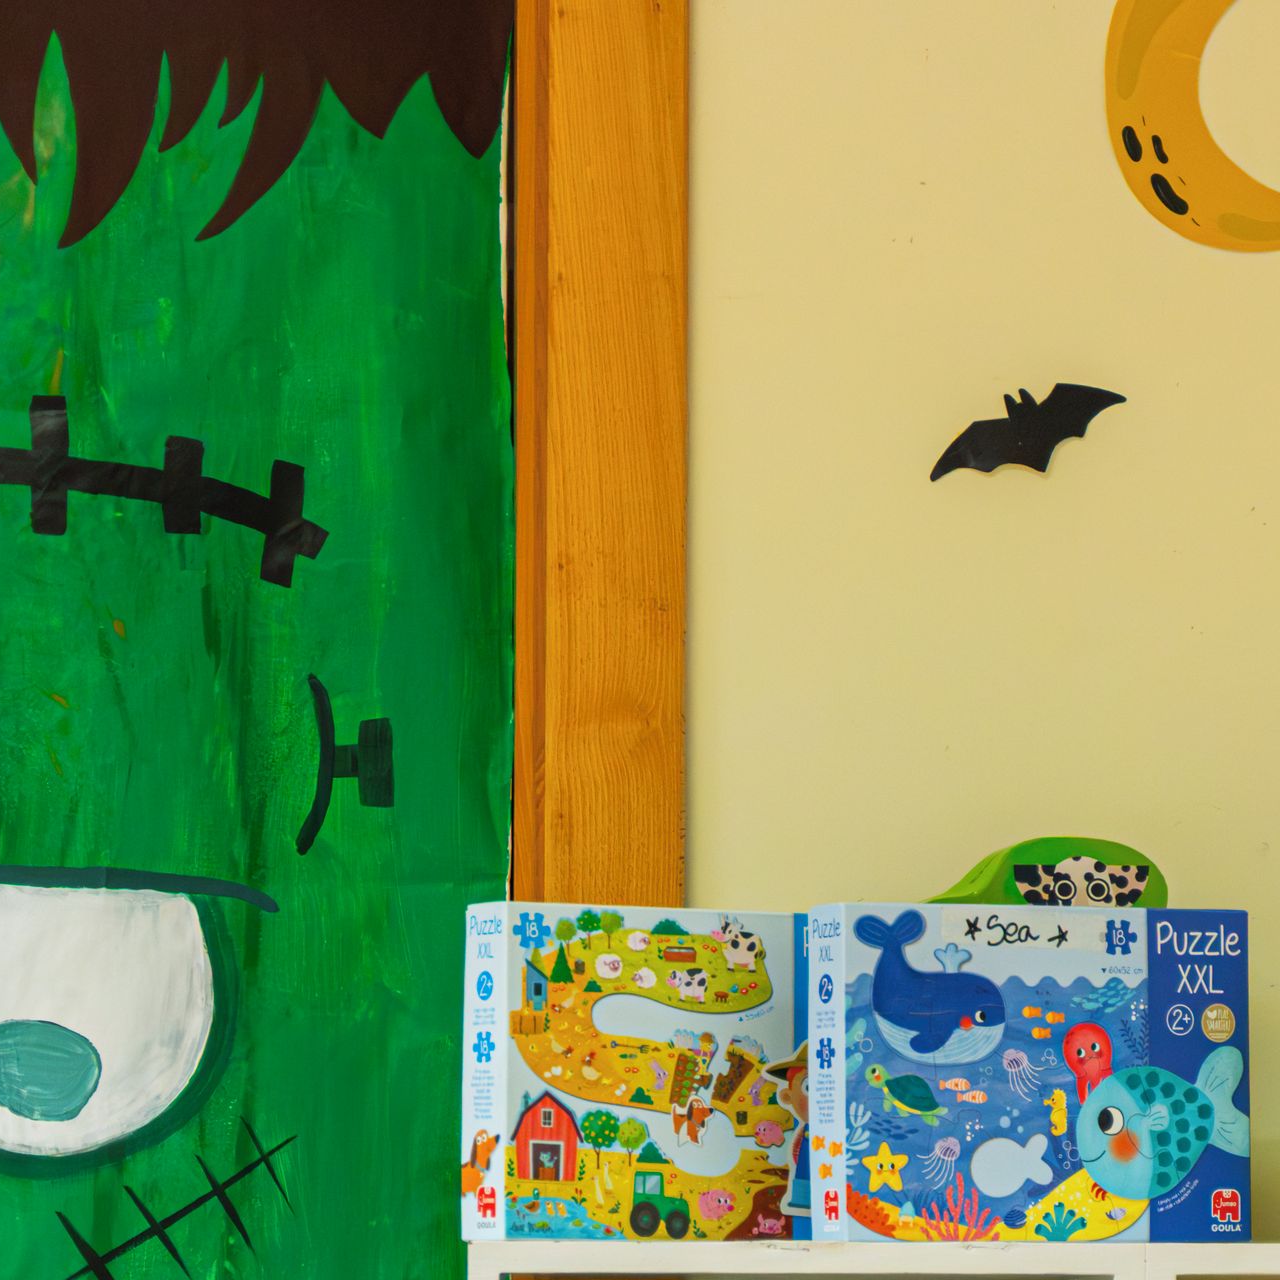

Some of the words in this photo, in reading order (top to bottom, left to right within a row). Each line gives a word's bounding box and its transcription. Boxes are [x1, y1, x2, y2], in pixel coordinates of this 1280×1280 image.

[470, 915, 503, 937] Puzzle
[525, 921, 539, 938] 18
[812, 918, 841, 939] Puzzle
[986, 915, 1040, 946] Sea
[1112, 929, 1126, 946] 18
[1156, 920, 1242, 956] Puzzle
[477, 942, 495, 959] XXL
[818, 946, 834, 962] XXL
[479, 975, 494, 997] 2+
[821, 978, 833, 1000] 2+
[1177, 964, 1224, 995] XXL
[1172, 1008, 1191, 1031] 2+
[1211, 1224, 1241, 1232] GOULA
